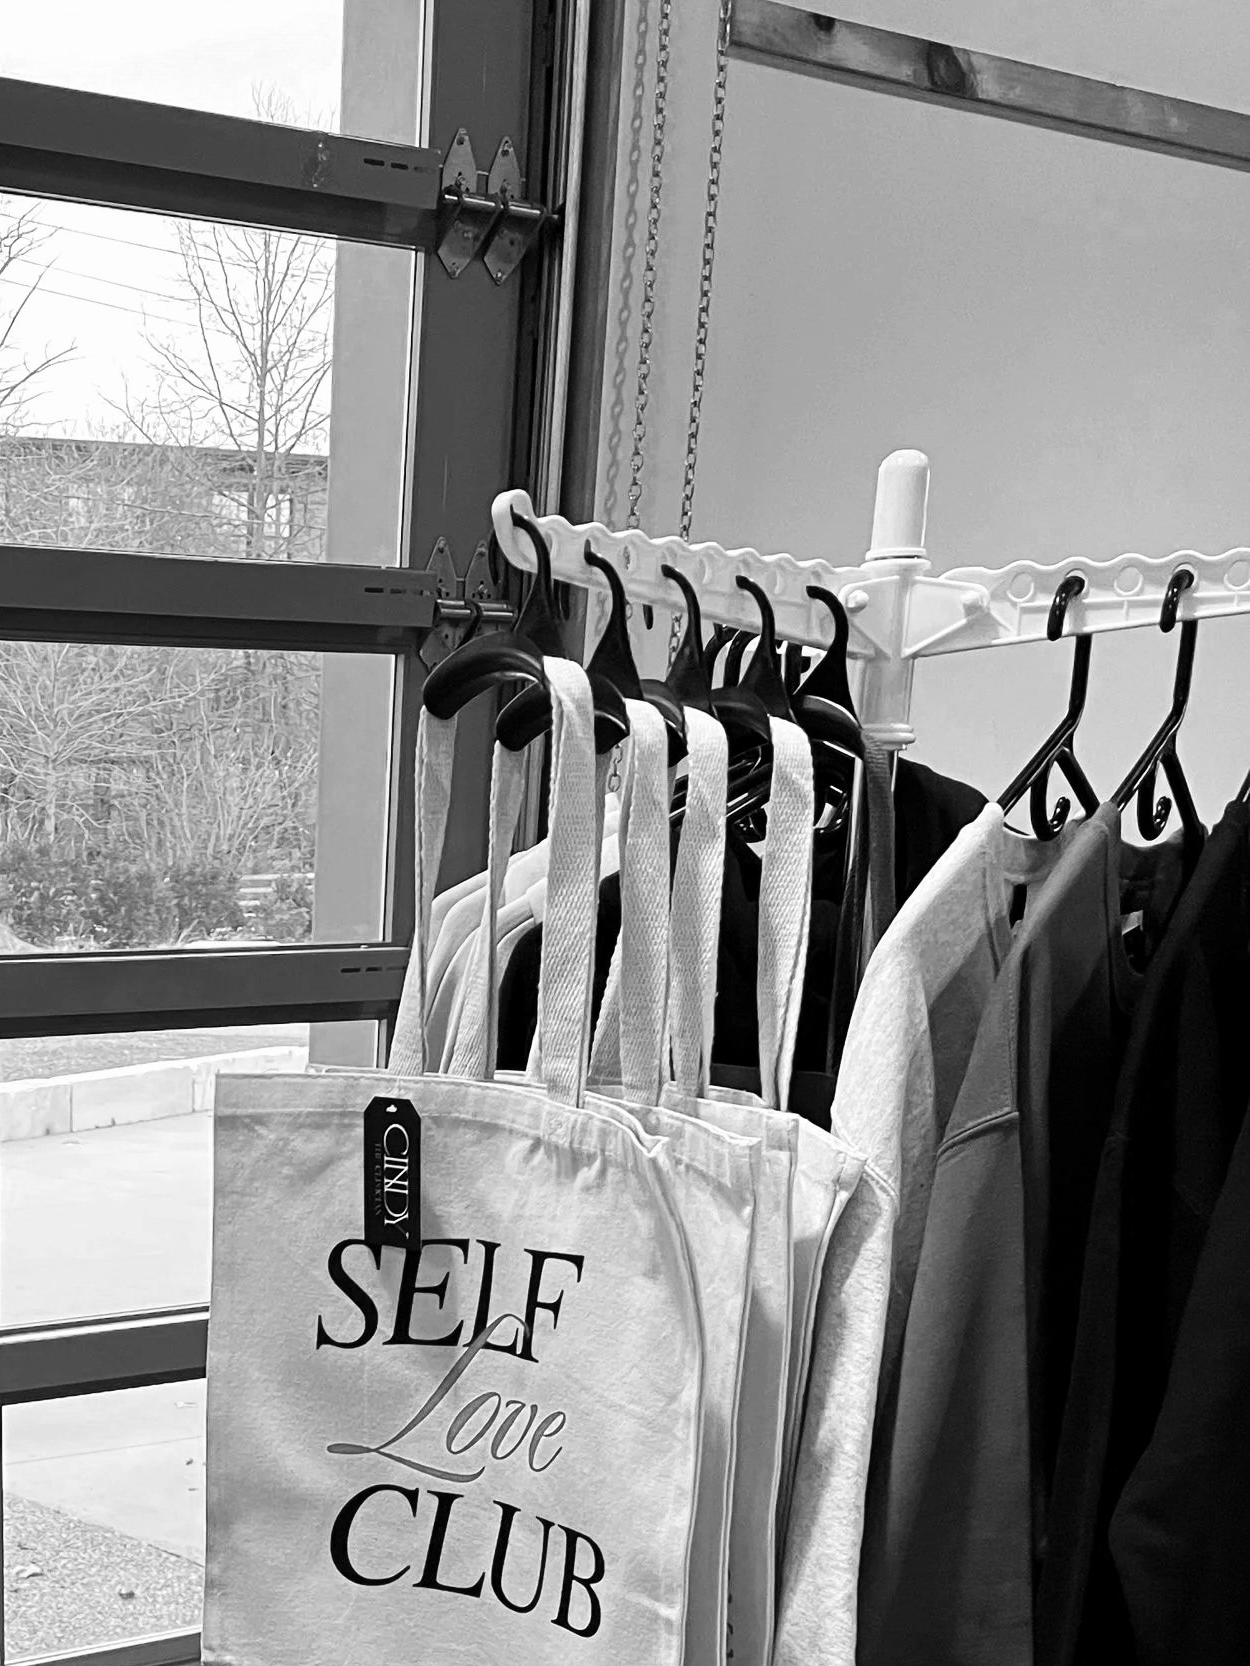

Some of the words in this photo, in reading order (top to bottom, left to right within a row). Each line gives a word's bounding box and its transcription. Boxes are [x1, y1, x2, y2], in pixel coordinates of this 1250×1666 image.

[383, 1122, 410, 1240] CINDY
[315, 1237, 585, 1363] SELF
[326, 1313, 567, 1483] Love
[329, 1483, 606, 1639] CLUB
